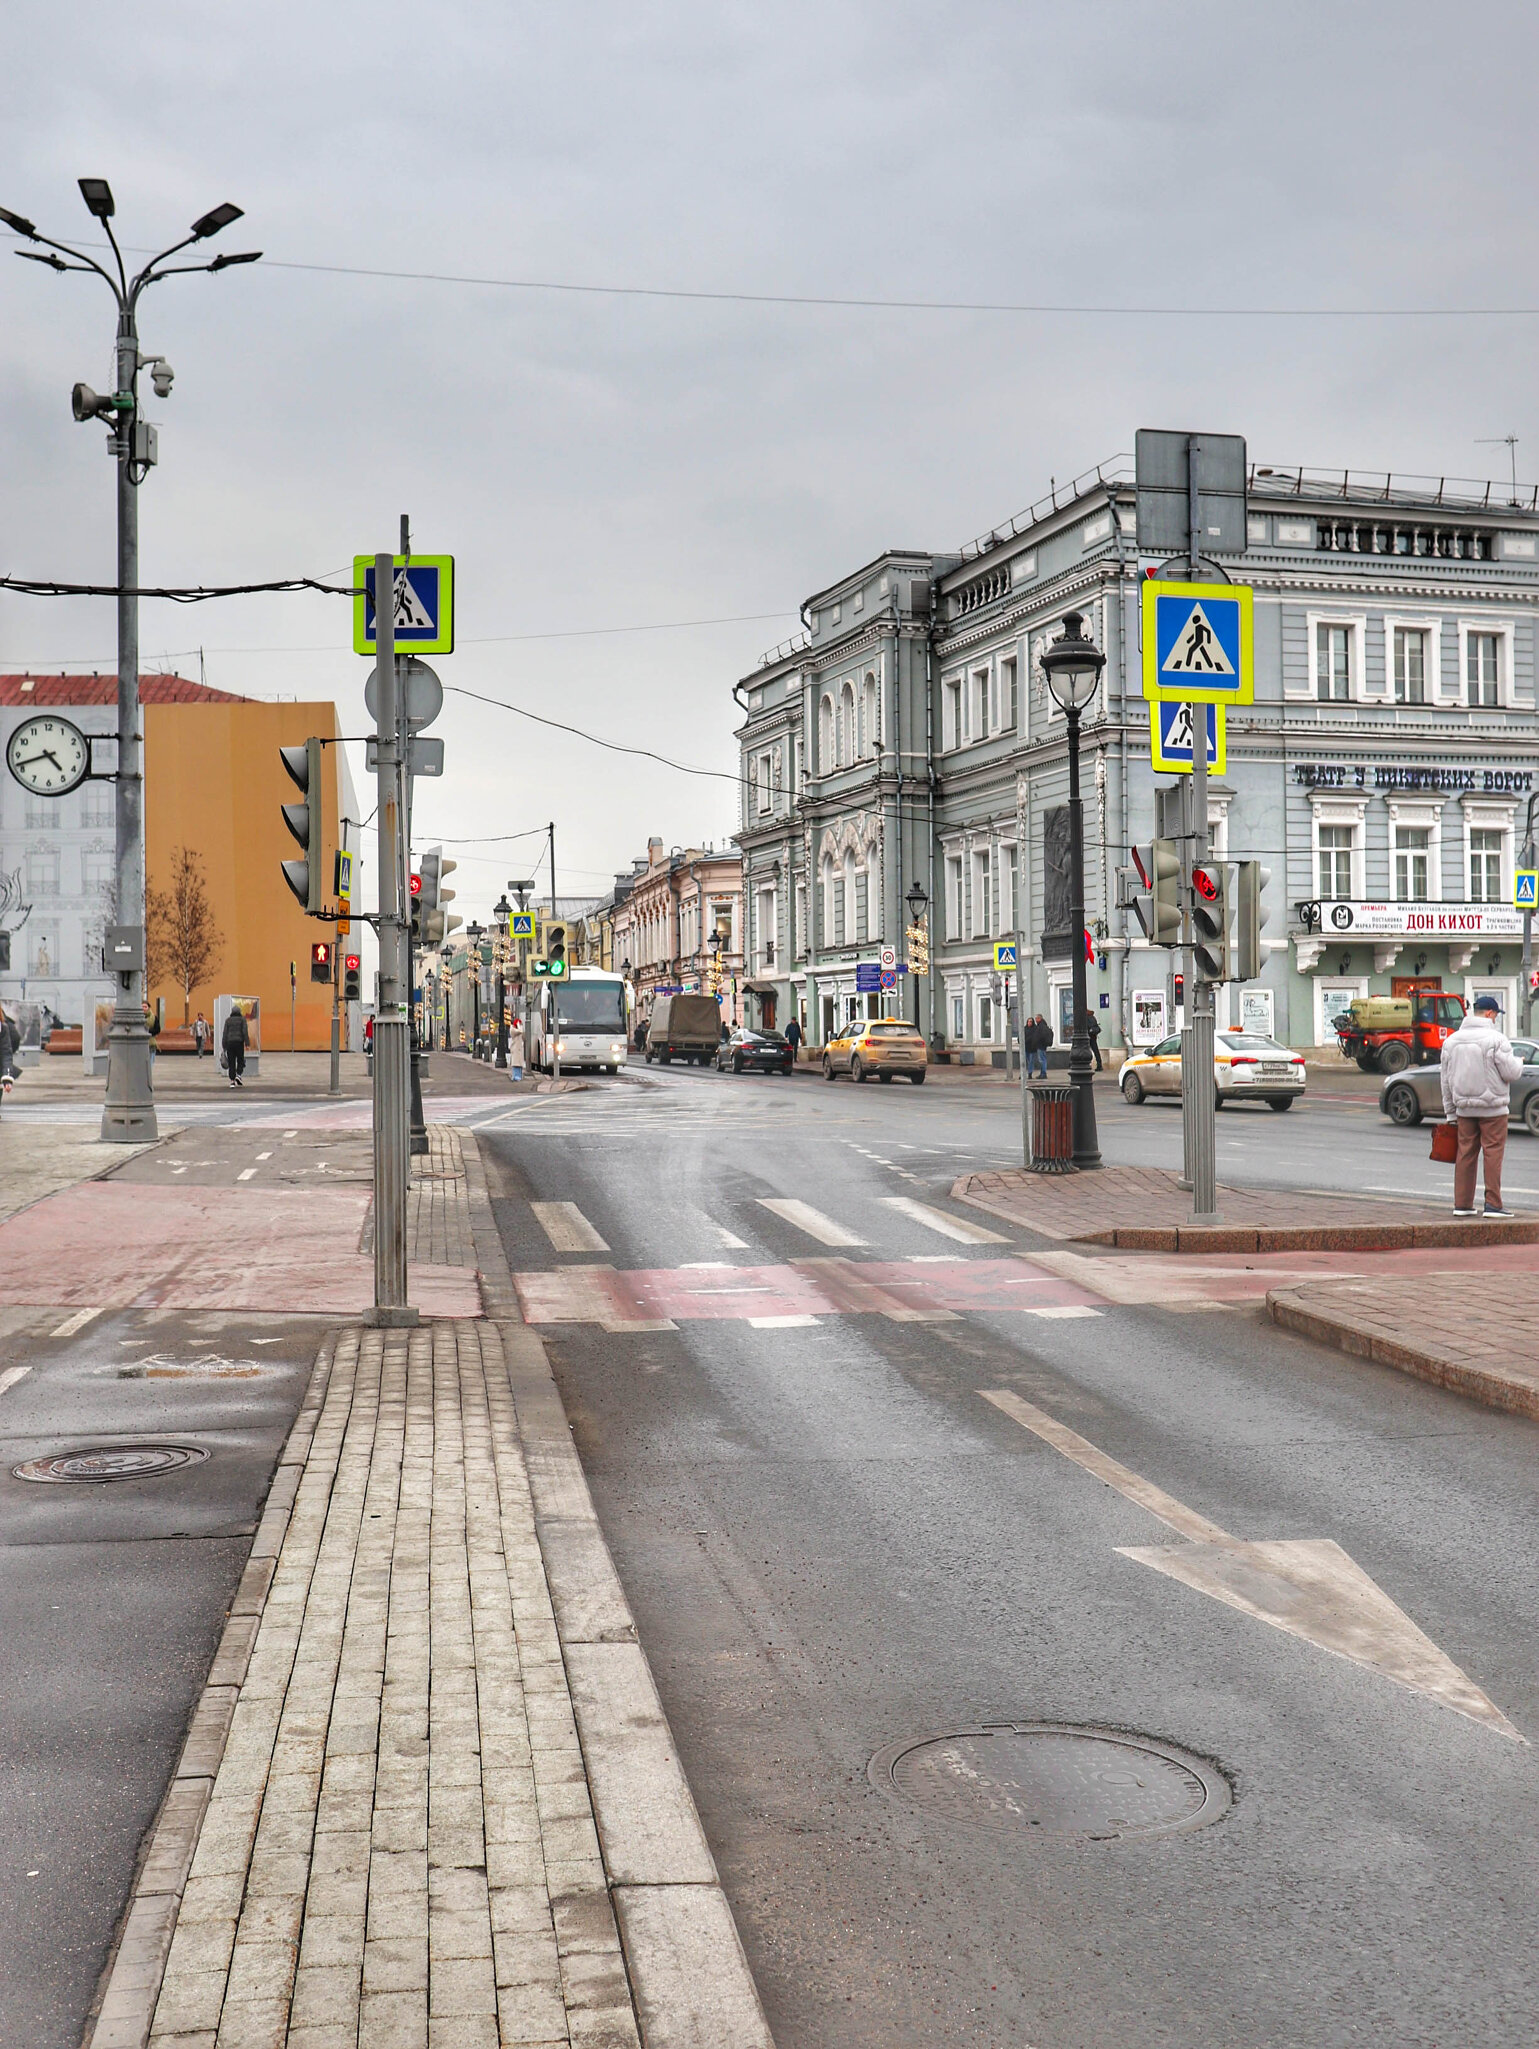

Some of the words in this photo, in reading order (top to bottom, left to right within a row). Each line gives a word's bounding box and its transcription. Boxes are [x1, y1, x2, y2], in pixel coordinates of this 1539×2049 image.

[44, 723, 53, 731] 12
[31, 728, 37, 736] 11
[15, 751, 21, 759] 9
[76, 751, 81, 759] 3
[20, 765, 25, 773] 8
[1294, 765, 1346, 785] ТЕАТР
[1354, 767, 1365, 785] У
[1375, 767, 1475, 789] НИКИТСКИХ
[1483, 770, 1533, 791] ВОРОТ
[46, 779, 51, 787] 6
[1406, 914, 1434, 930] ДОН
[1438, 914, 1483, 930] КИХОТ
